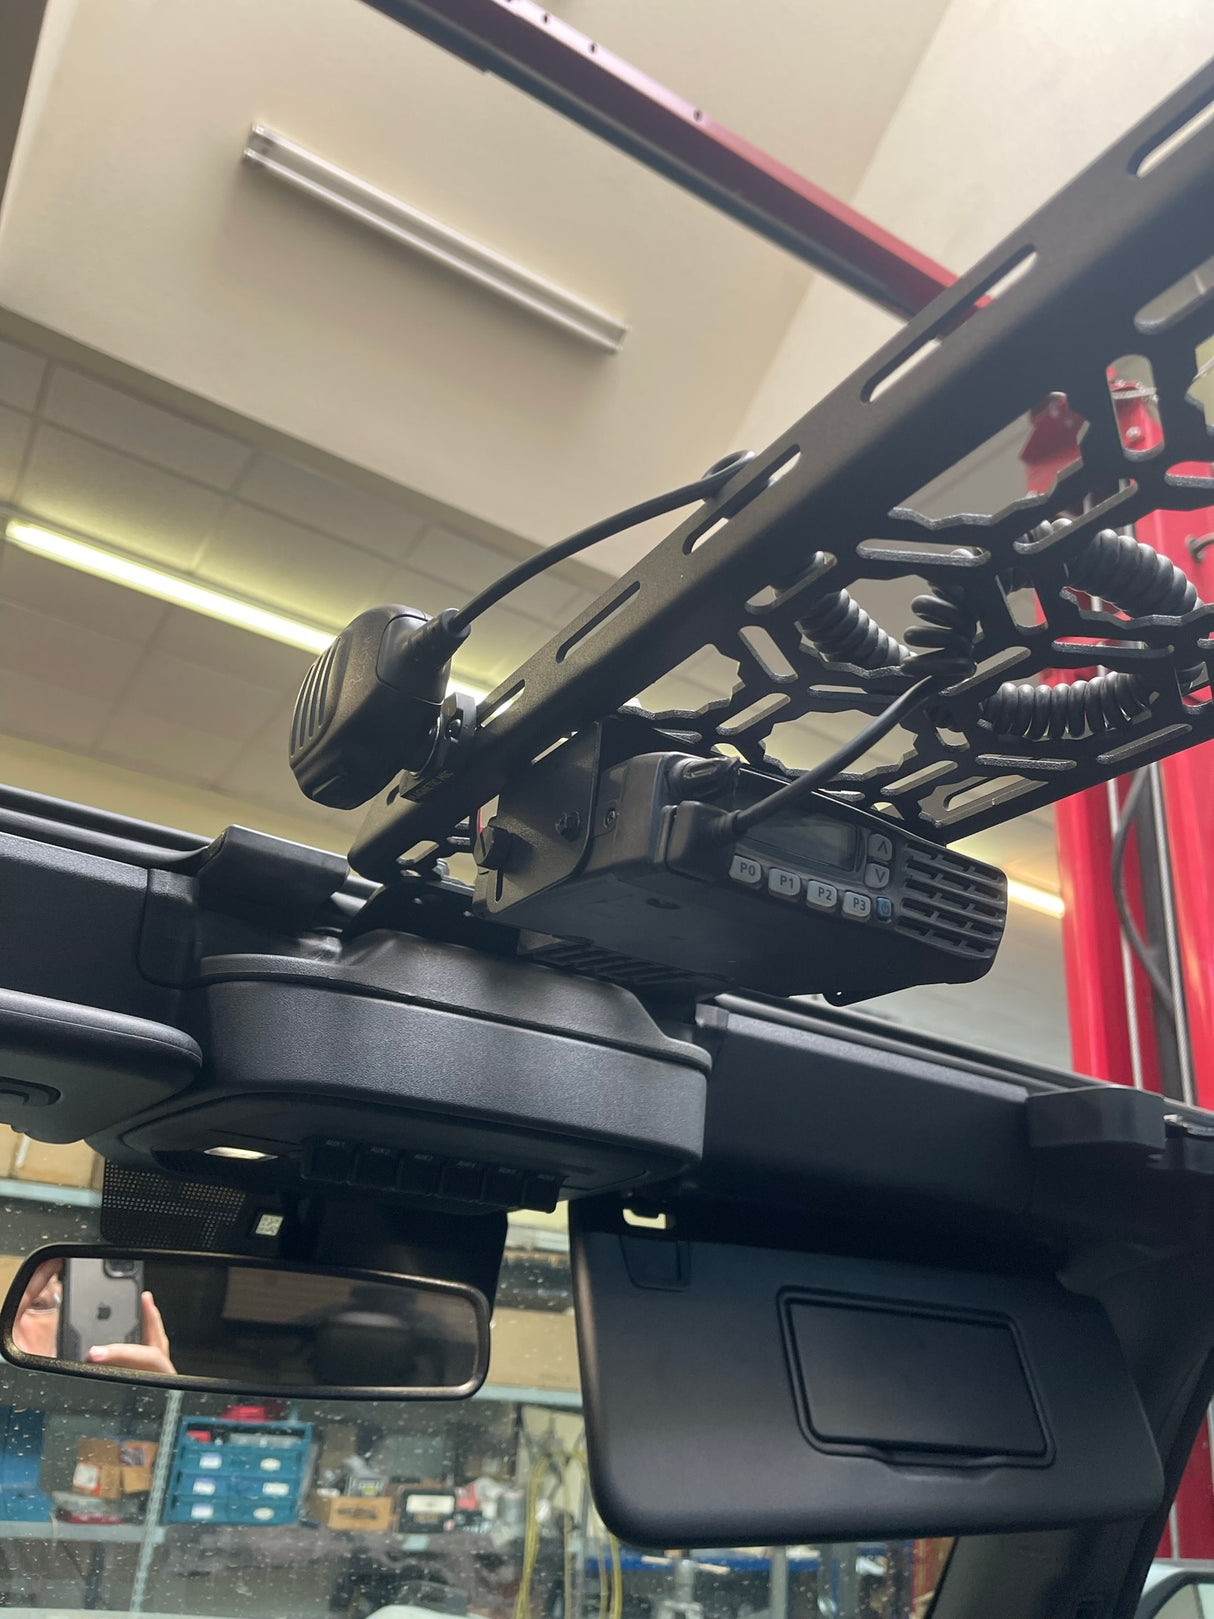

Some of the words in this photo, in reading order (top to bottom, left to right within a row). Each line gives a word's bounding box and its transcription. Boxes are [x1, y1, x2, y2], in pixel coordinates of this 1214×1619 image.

[779, 875, 794, 889] P1
[817, 886, 832, 901] P2
[853, 897, 866, 911] P3
